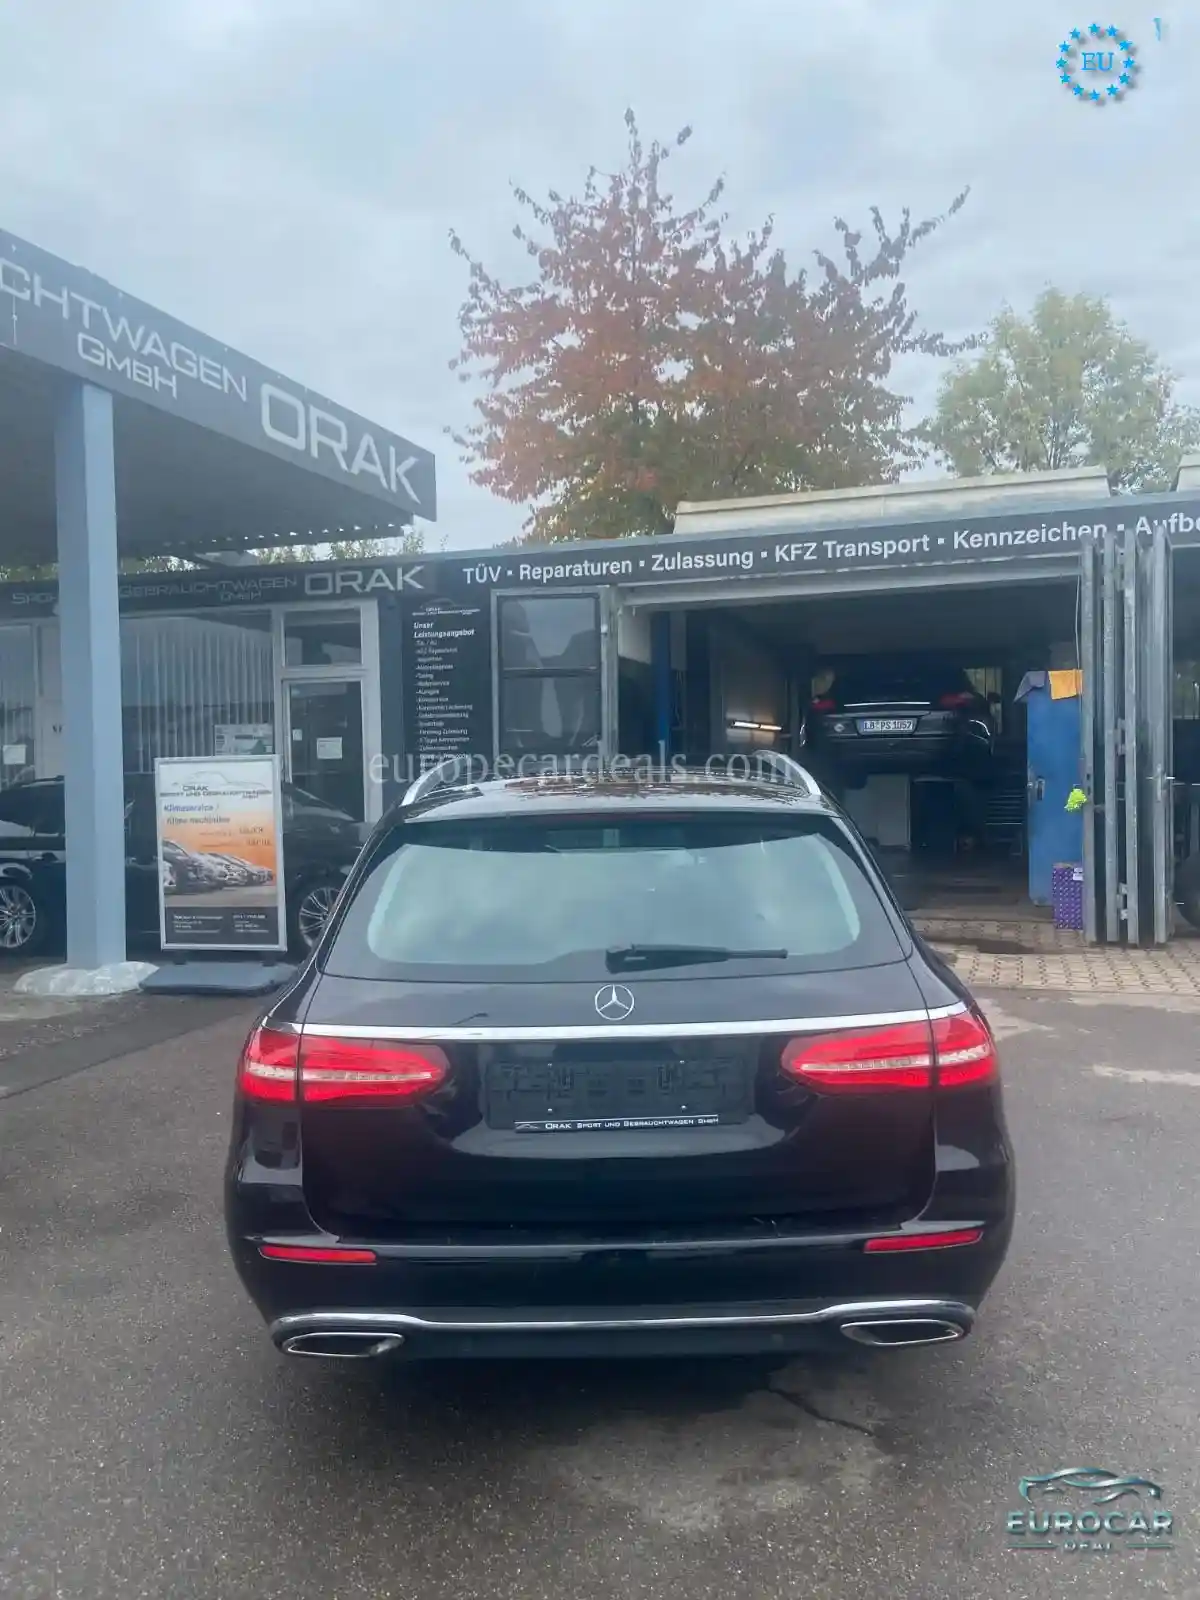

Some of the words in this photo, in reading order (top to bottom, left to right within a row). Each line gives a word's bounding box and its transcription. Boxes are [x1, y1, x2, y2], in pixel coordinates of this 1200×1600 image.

[77, 332, 177, 398] GMBH
[260, 382, 421, 504] ORAK
[304, 565, 425, 596] ORAK
[462, 565, 501, 584] TÜV
[519, 558, 632, 583] Reparaturen
[651, 549, 754, 571] Zulassung
[775, 542, 818, 563] KFZ
[822, 534, 930, 559] Transport
[953, 521, 1108, 550] Kennzeichen
[880, 720, 891, 730] PS
